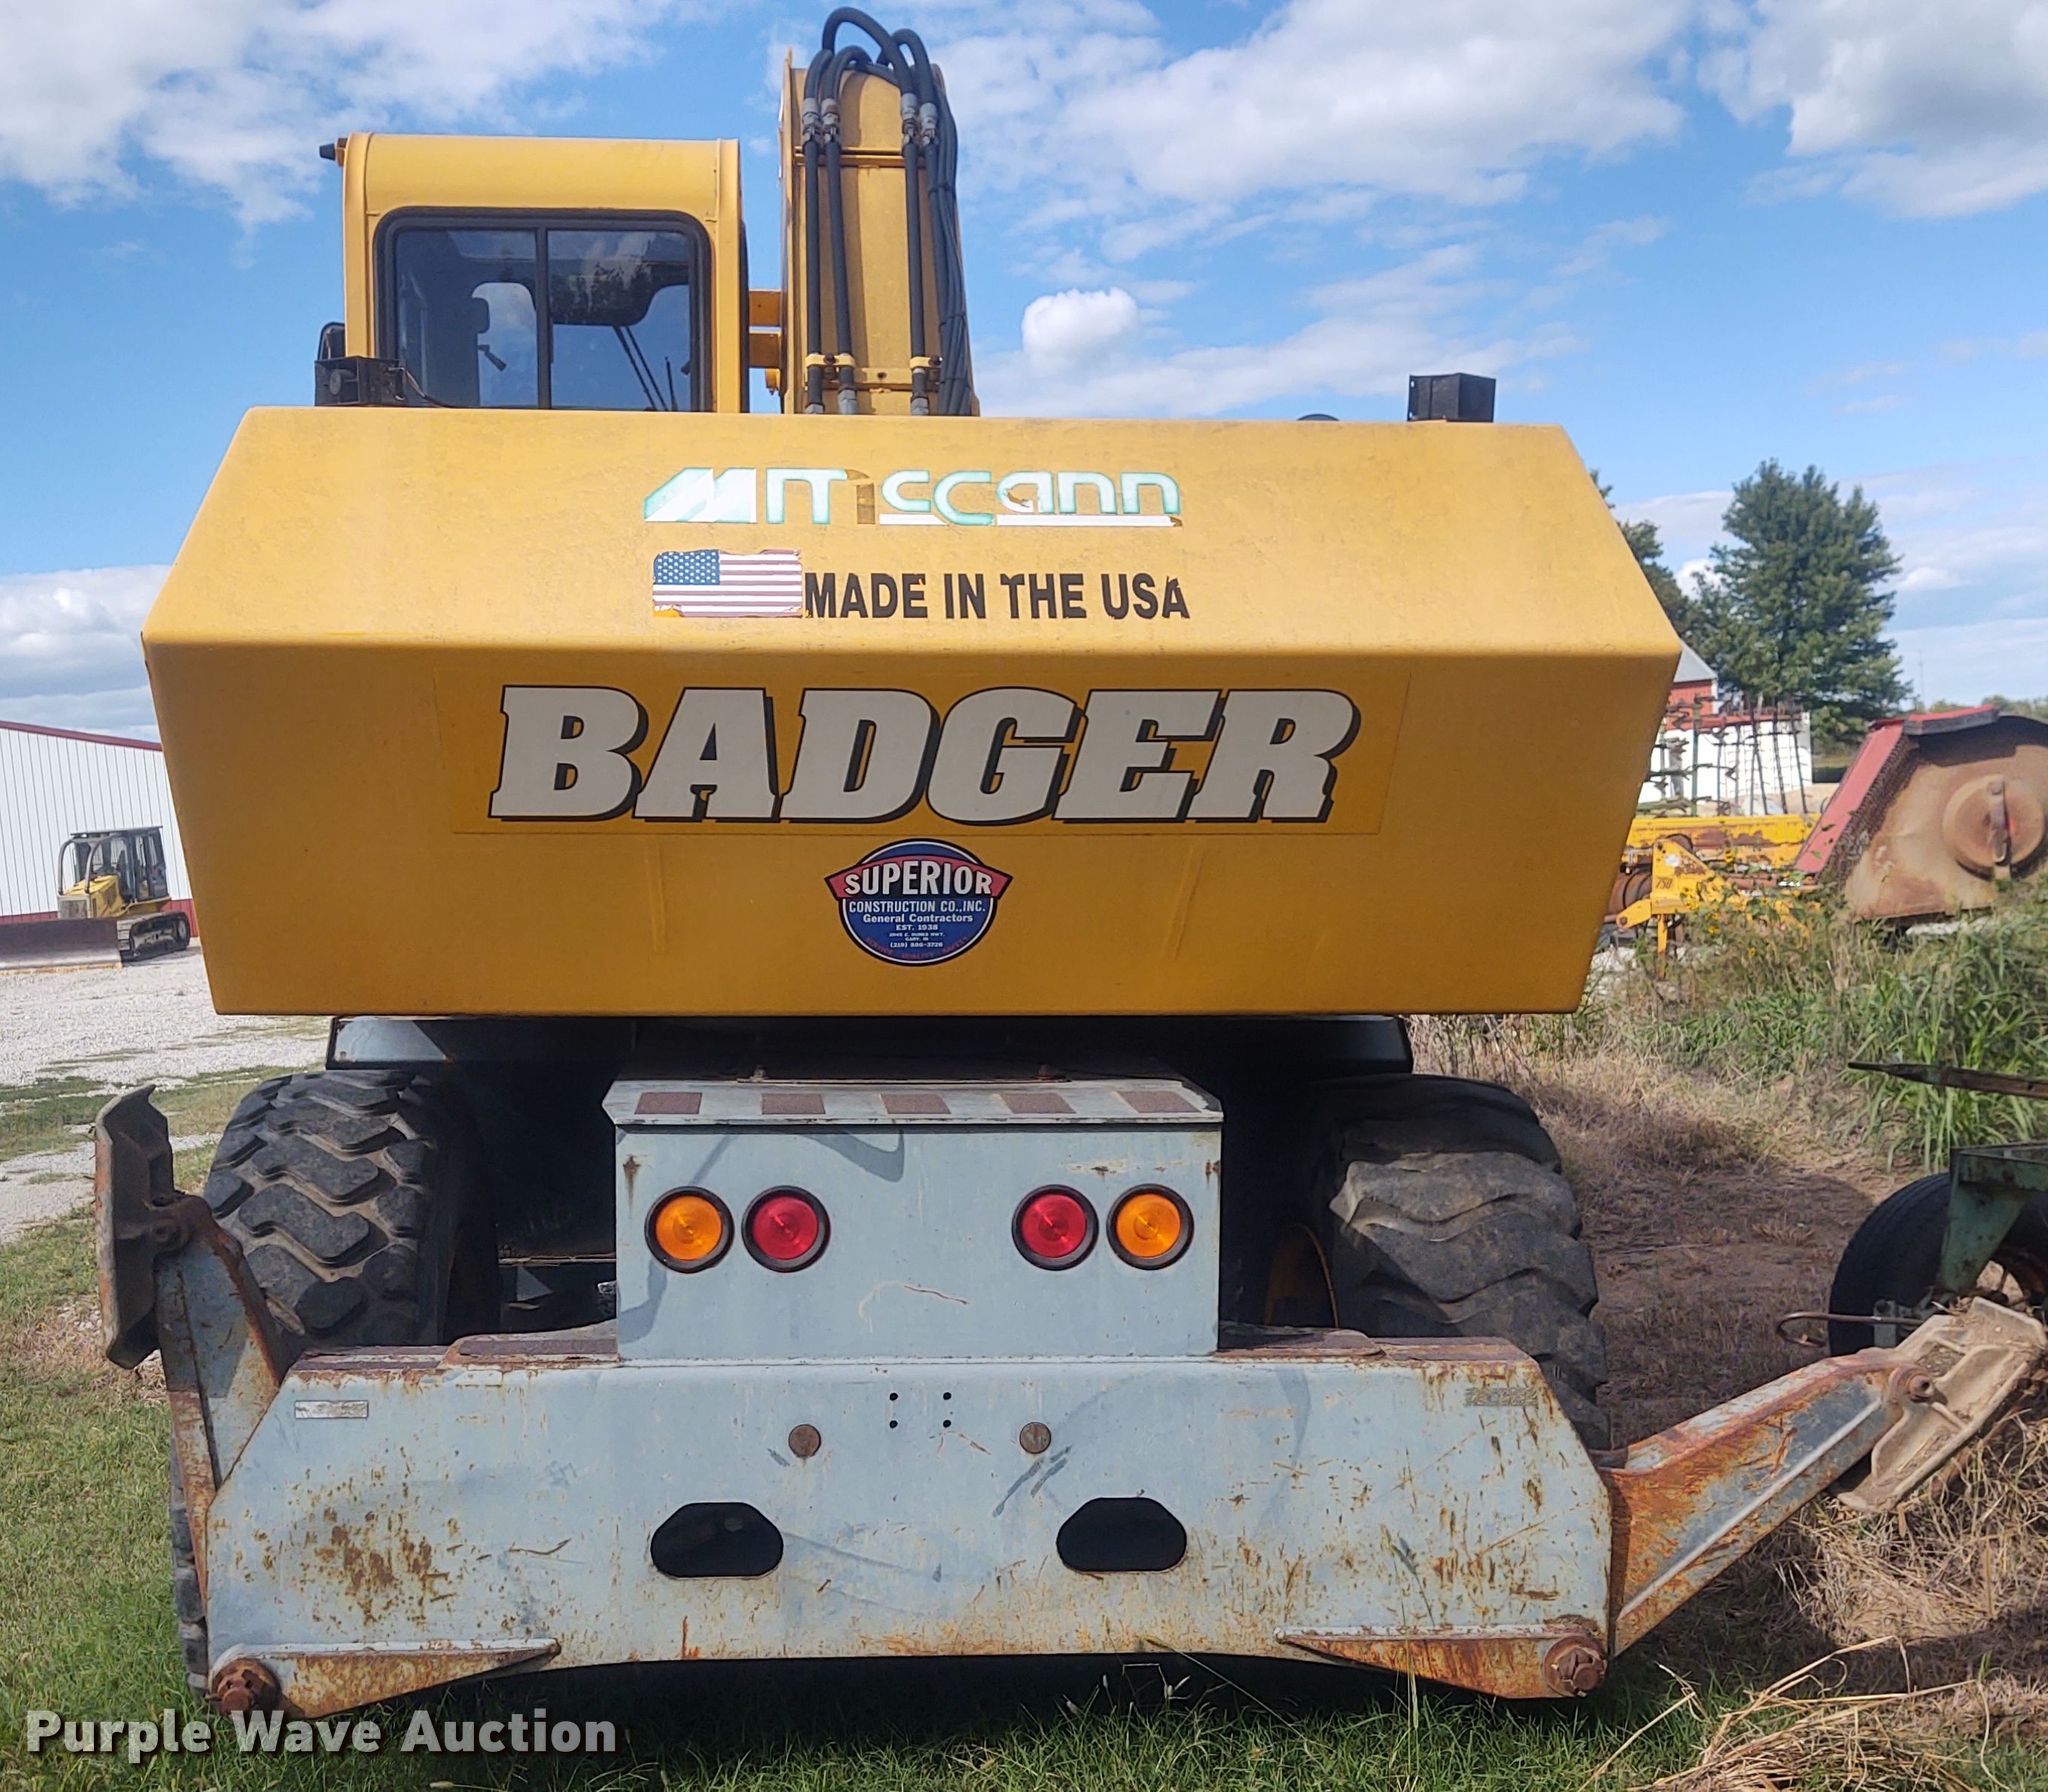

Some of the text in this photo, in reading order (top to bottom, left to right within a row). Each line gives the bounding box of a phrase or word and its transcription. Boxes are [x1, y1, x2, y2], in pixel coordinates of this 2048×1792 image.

[806, 571, 1191, 620] MADE IN THE USA
[488, 684, 1362, 825] BADGER
[844, 860, 993, 896] SUPERIOR
[849, 900, 936, 913] CONSTRUCTION
[862, 913, 974, 923] General Contractors
